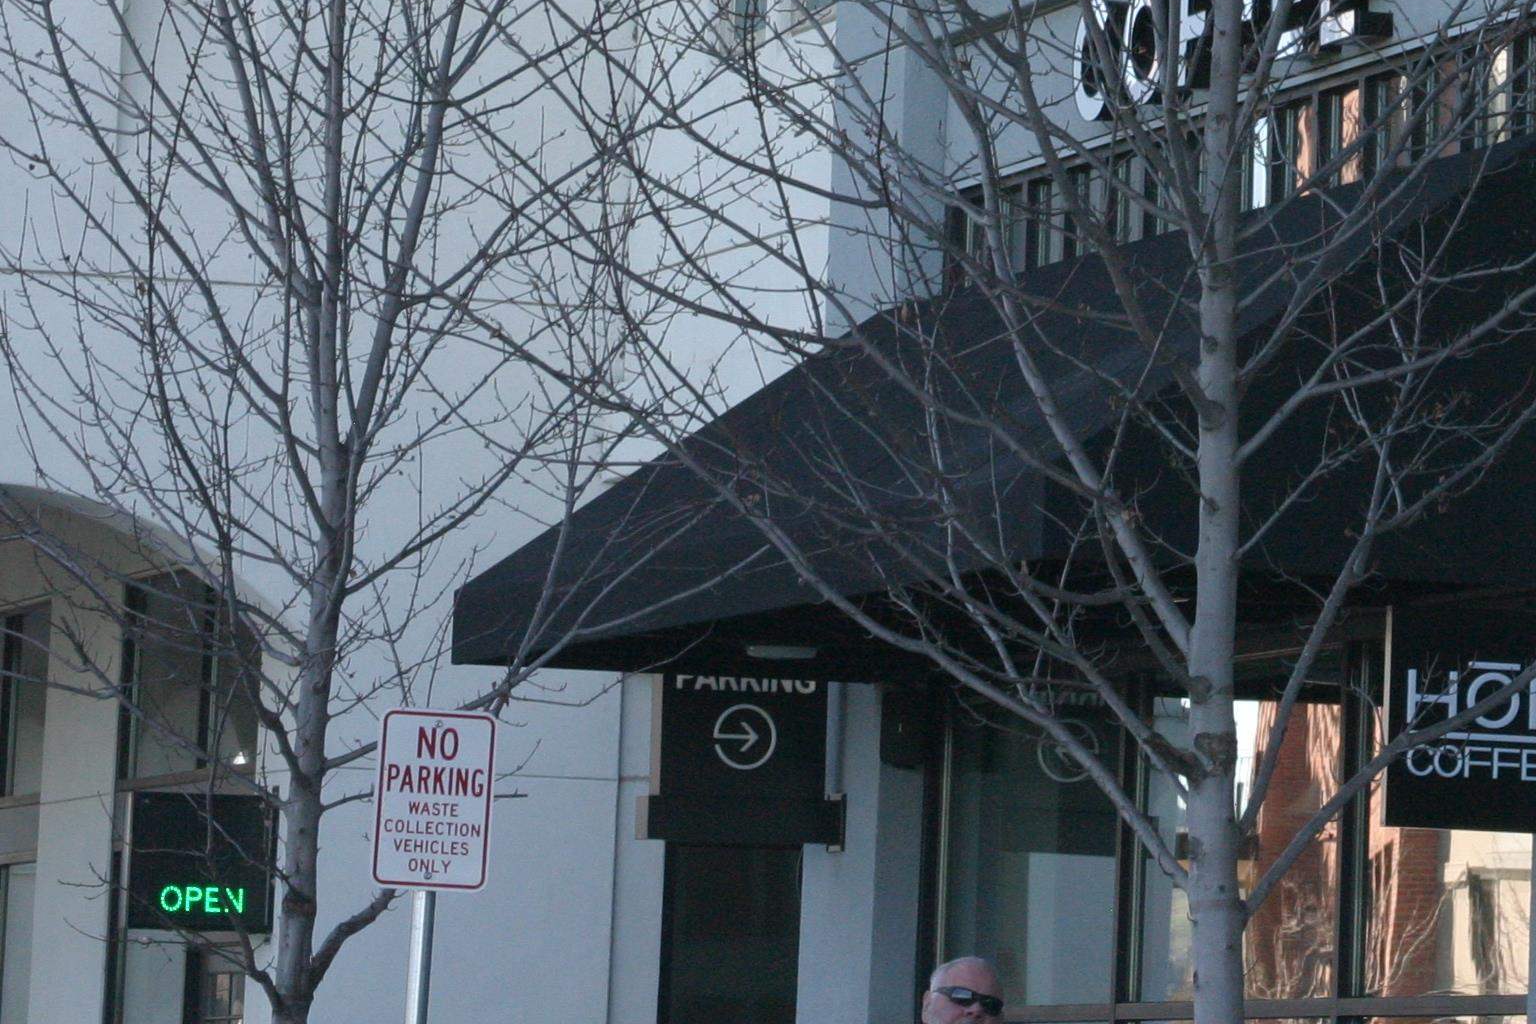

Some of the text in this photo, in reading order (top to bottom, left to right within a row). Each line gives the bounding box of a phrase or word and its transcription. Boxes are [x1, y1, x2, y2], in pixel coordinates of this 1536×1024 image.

[416, 726, 460, 761] NO
[386, 764, 485, 797] PARKING
[408, 801, 459, 817] WASTE
[384, 819, 481, 837] COLLECTION
[393, 838, 469, 856] VEHICLES
[408, 858, 451, 874] ONLY
[161, 885, 244, 913] OPEN
